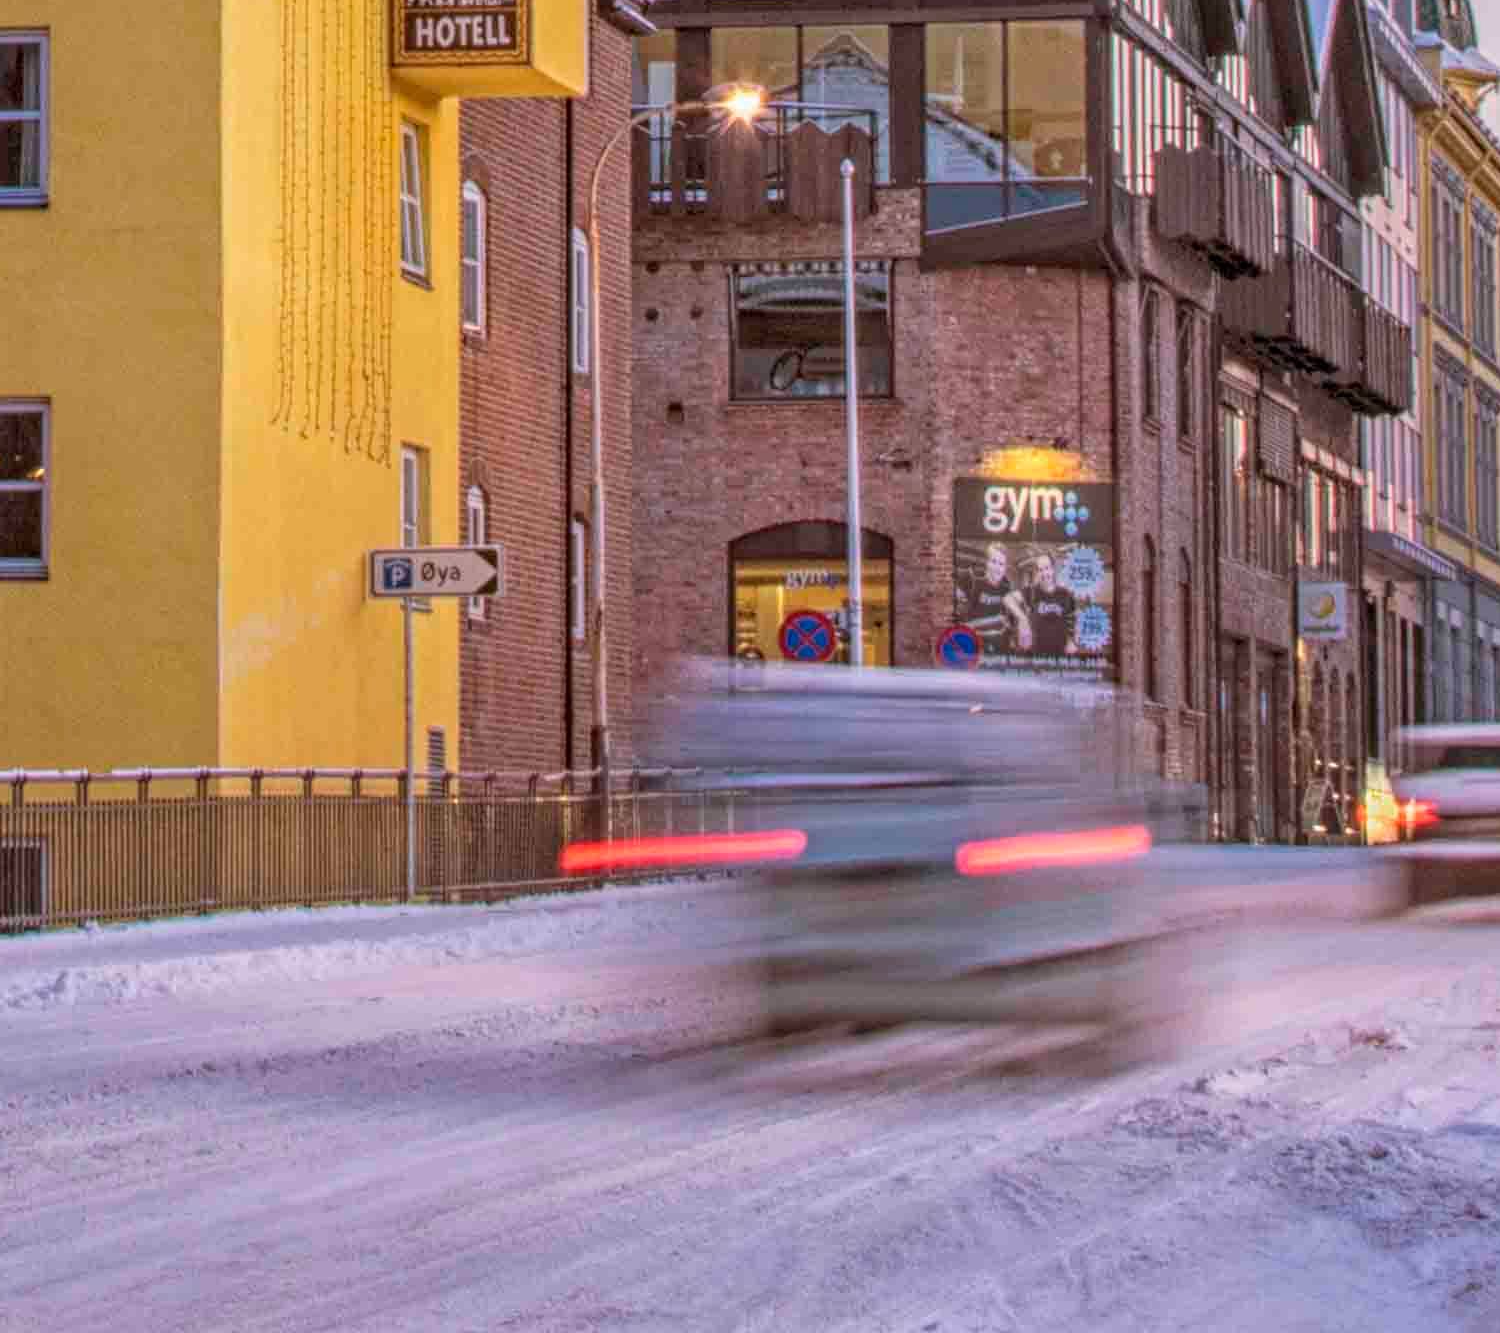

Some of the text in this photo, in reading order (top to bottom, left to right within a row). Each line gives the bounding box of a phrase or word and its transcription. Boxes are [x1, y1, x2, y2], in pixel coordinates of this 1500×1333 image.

[415, 14, 511, 48] HOTELL
[982, 485, 1064, 533] gym
[391, 561, 461, 587] P Øya
